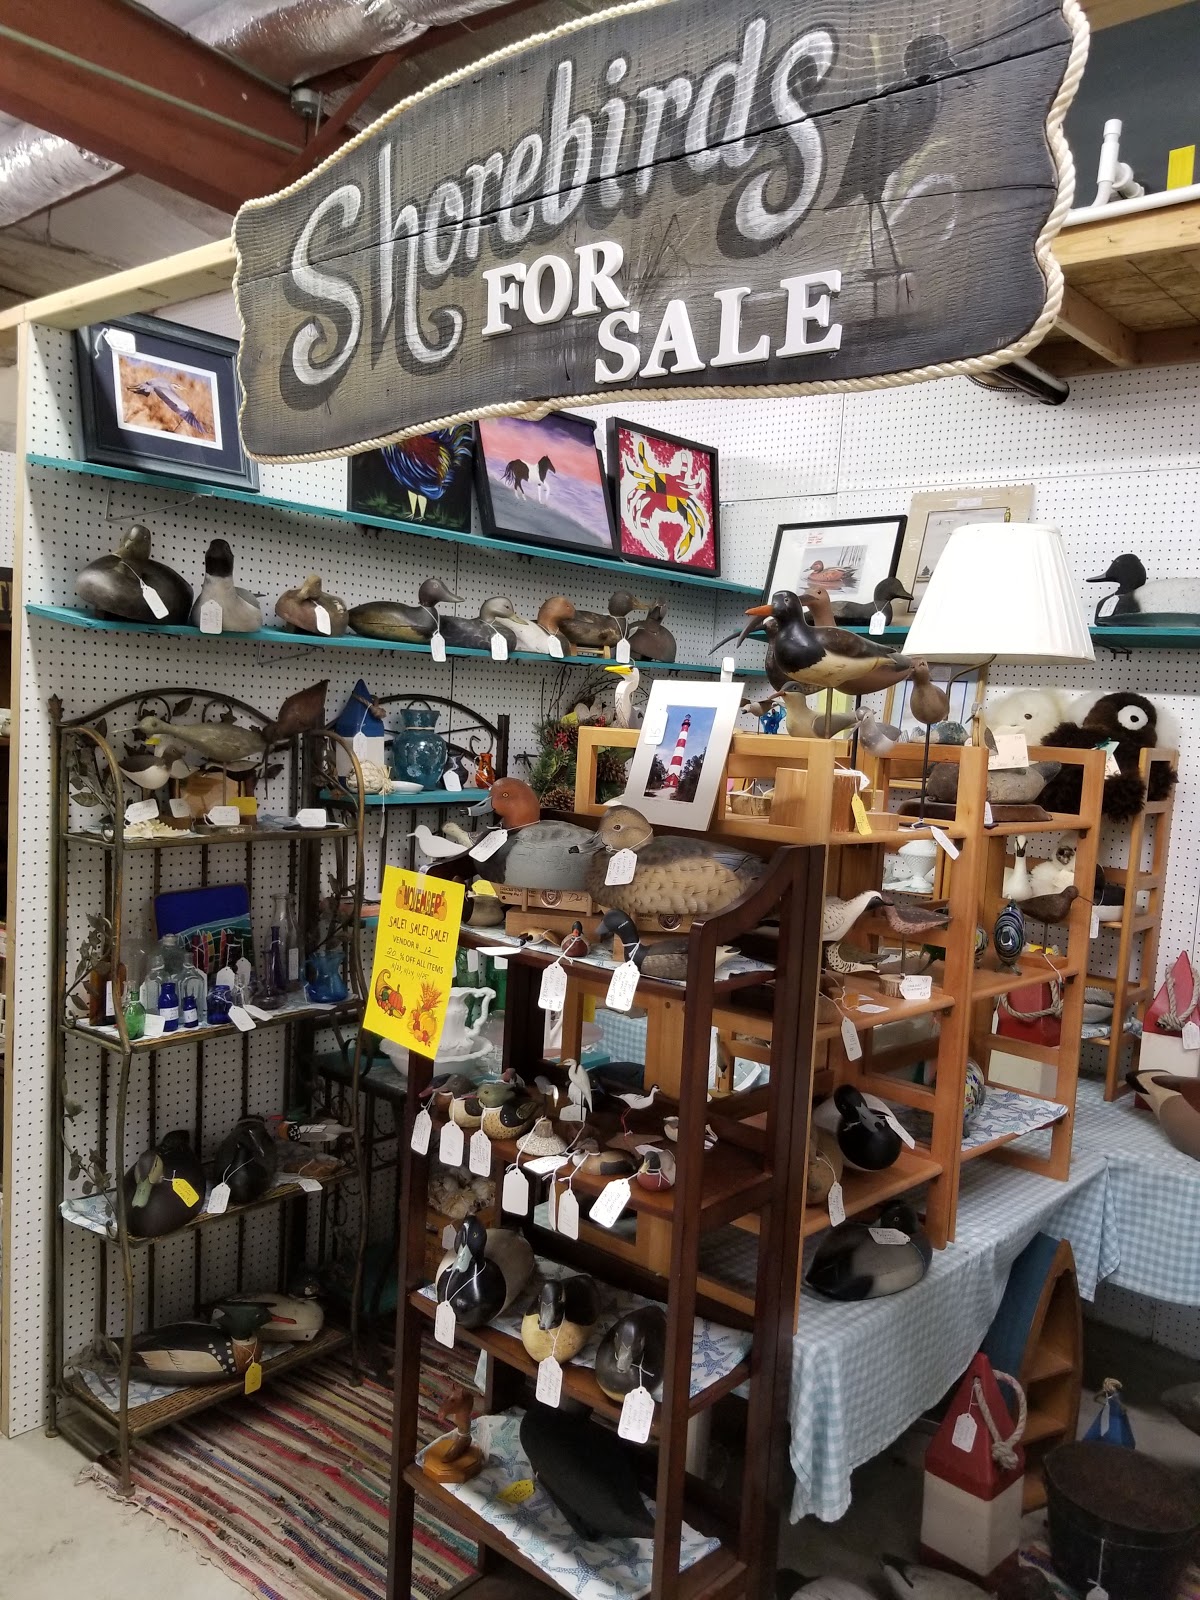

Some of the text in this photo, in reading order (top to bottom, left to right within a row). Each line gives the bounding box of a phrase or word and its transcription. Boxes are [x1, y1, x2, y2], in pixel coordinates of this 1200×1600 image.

[481, 239, 629, 338] FOR
[595, 269, 843, 384] SALE
[404, 884, 443, 916] NOVEMBER
[392, 935, 415, 949] VENDOR
[386, 947, 397, 957] 20
[405, 955, 416, 965] OFF
[416, 959, 426, 968] ALL
[426, 962, 444, 975] ITEMS
